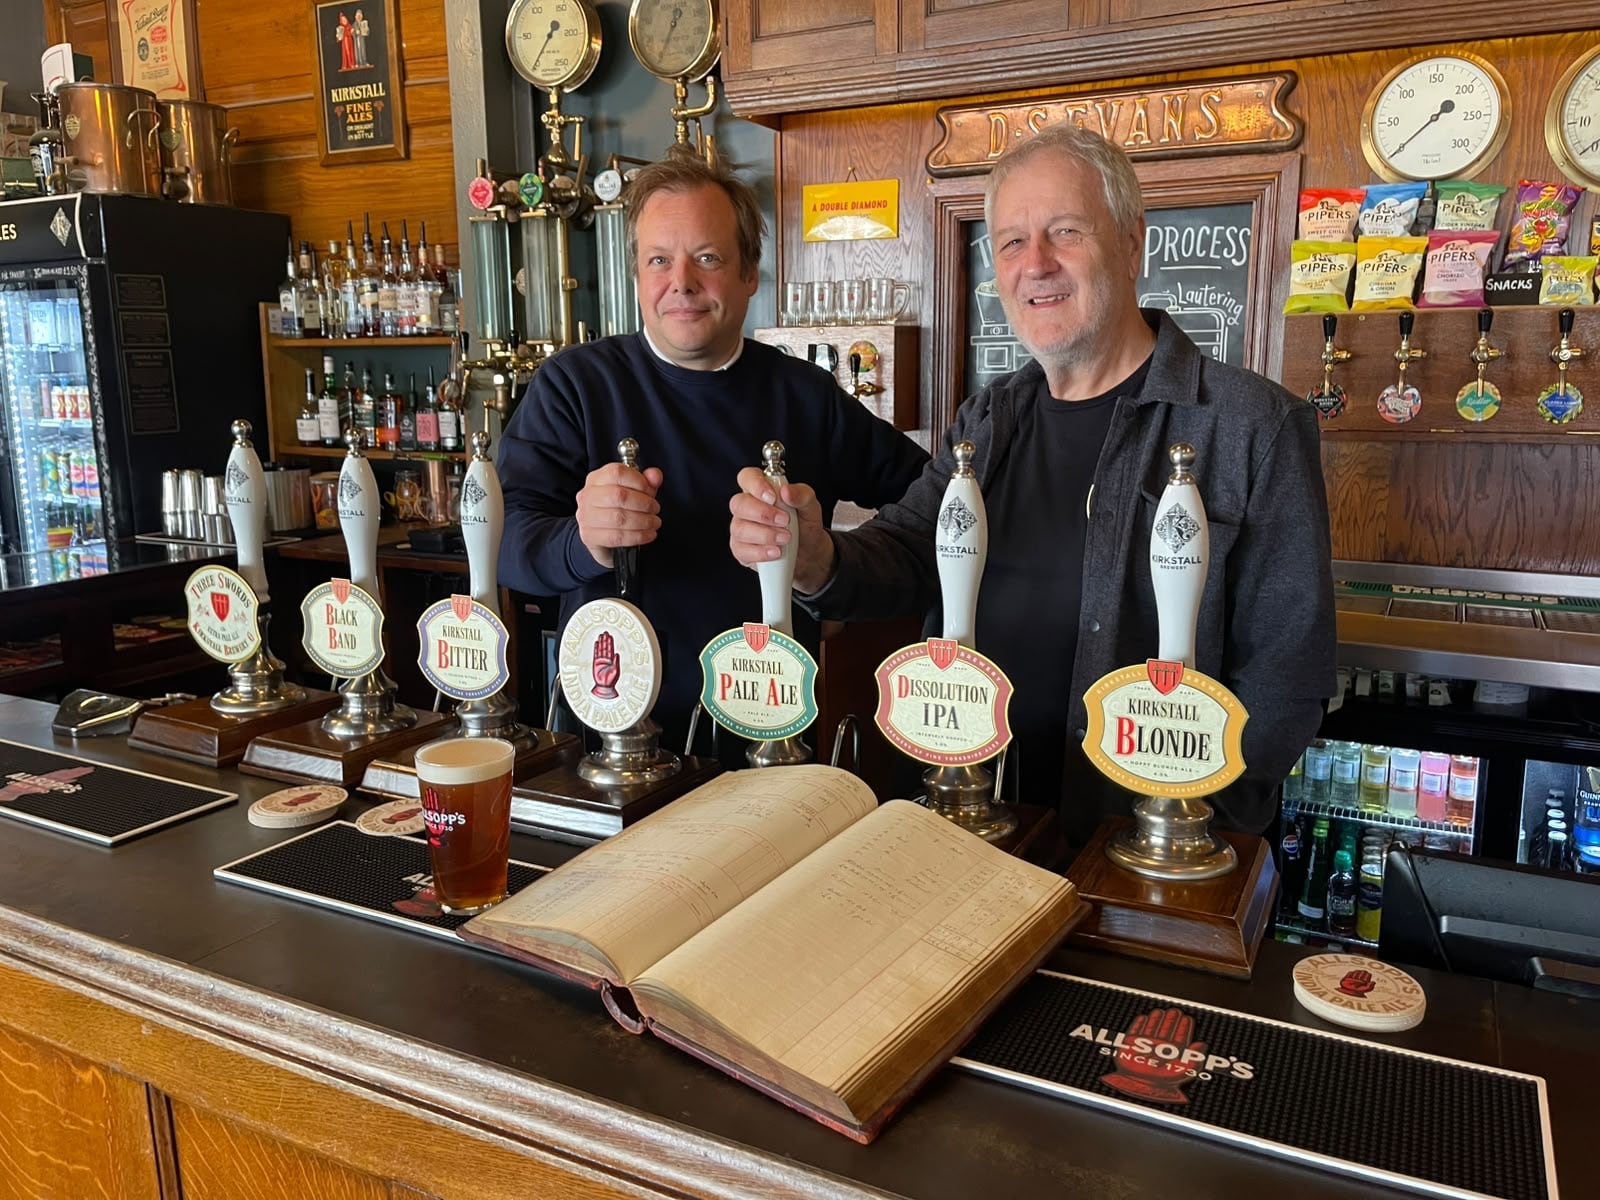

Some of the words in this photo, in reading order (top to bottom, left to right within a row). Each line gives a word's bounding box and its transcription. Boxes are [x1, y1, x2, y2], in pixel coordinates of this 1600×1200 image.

[556, 4, 567, 12] 150
[522, 32, 532, 40] 50
[564, 28, 578, 37] 200
[554, 58, 569, 66] 250
[1429, 73, 1445, 84] 150
[331, 82, 386, 103] KIRKSTALL
[1399, 88, 1415, 100] 100
[1455, 84, 1475, 95] 200
[346, 101, 373, 113] FINE
[1463, 110, 1483, 121] 250
[346, 111, 374, 124] ALES
[1386, 116, 1400, 127] 50
[1579, 115, 1592, 128] 10
[1451, 138, 1470, 149] 300
[1591, 141, 1599, 152] 0
[812, 203, 818, 212] A
[820, 201, 849, 212] DOUBLE
[851, 199, 888, 211] DIAMOND
[1308, 210, 1351, 221] PIPERS
[1142, 225, 1251, 279] PROCESS
[1431, 251, 1475, 264] PIPERS
[1300, 262, 1344, 273] PIPERS
[1363, 262, 1408, 273] PIPERS
[1485, 278, 1533, 291] SNACKS
[1177, 282, 1244, 327] Lautering
[191, 574, 216, 600] THREE
[217, 573, 251, 609] SWORDS
[325, 603, 358, 627] BLACK
[193, 621, 222, 654] KIRKSTALL
[223, 640, 249, 657] BREWERY
[328, 627, 357, 650] BAND
[442, 624, 483, 642] KIRKSTALL
[565, 604, 650, 667] ALLSOPP'S
[437, 638, 489, 673] BITTER
[885, 648, 925, 672] KIRKSTALL
[960, 650, 1003, 682] BREWERY
[732, 657, 785, 676] KIRKSTALL
[562, 664, 593, 721] INDIA
[591, 702, 631, 729] PALE
[627, 674, 650, 717] ALE
[720, 672, 760, 703] PALE
[766, 677, 799, 707] ALE
[897, 674, 989, 705] DISSOLUTION
[1096, 670, 1143, 695] KIRKSTALL
[1185, 673, 1235, 709] BREWERY
[923, 702, 961, 731] IPA
[1128, 697, 1201, 722] KIRKSTALL
[1114, 715, 1212, 762] BLONDE
[1094, 753, 1126, 781] BREWERS
[1128, 776, 1139, 786] OF
[1141, 782, 1161, 793] FINE
[1164, 782, 1210, 794] YORKSHIRE
[1212, 771, 1232, 785] ALES
[1153, 763, 1178, 772] BLONDE
[1308, 955, 1420, 996] ALLSOPP'S
[1295, 970, 1329, 999] INDIA
[1329, 996, 1376, 1013] PALE
[1380, 998, 1414, 1013] ALE
[1068, 1023, 1255, 1081] ALLSOPP'S
[1099, 1046, 1158, 1068] SINCE
[1164, 1062, 1213, 1081] 1730
